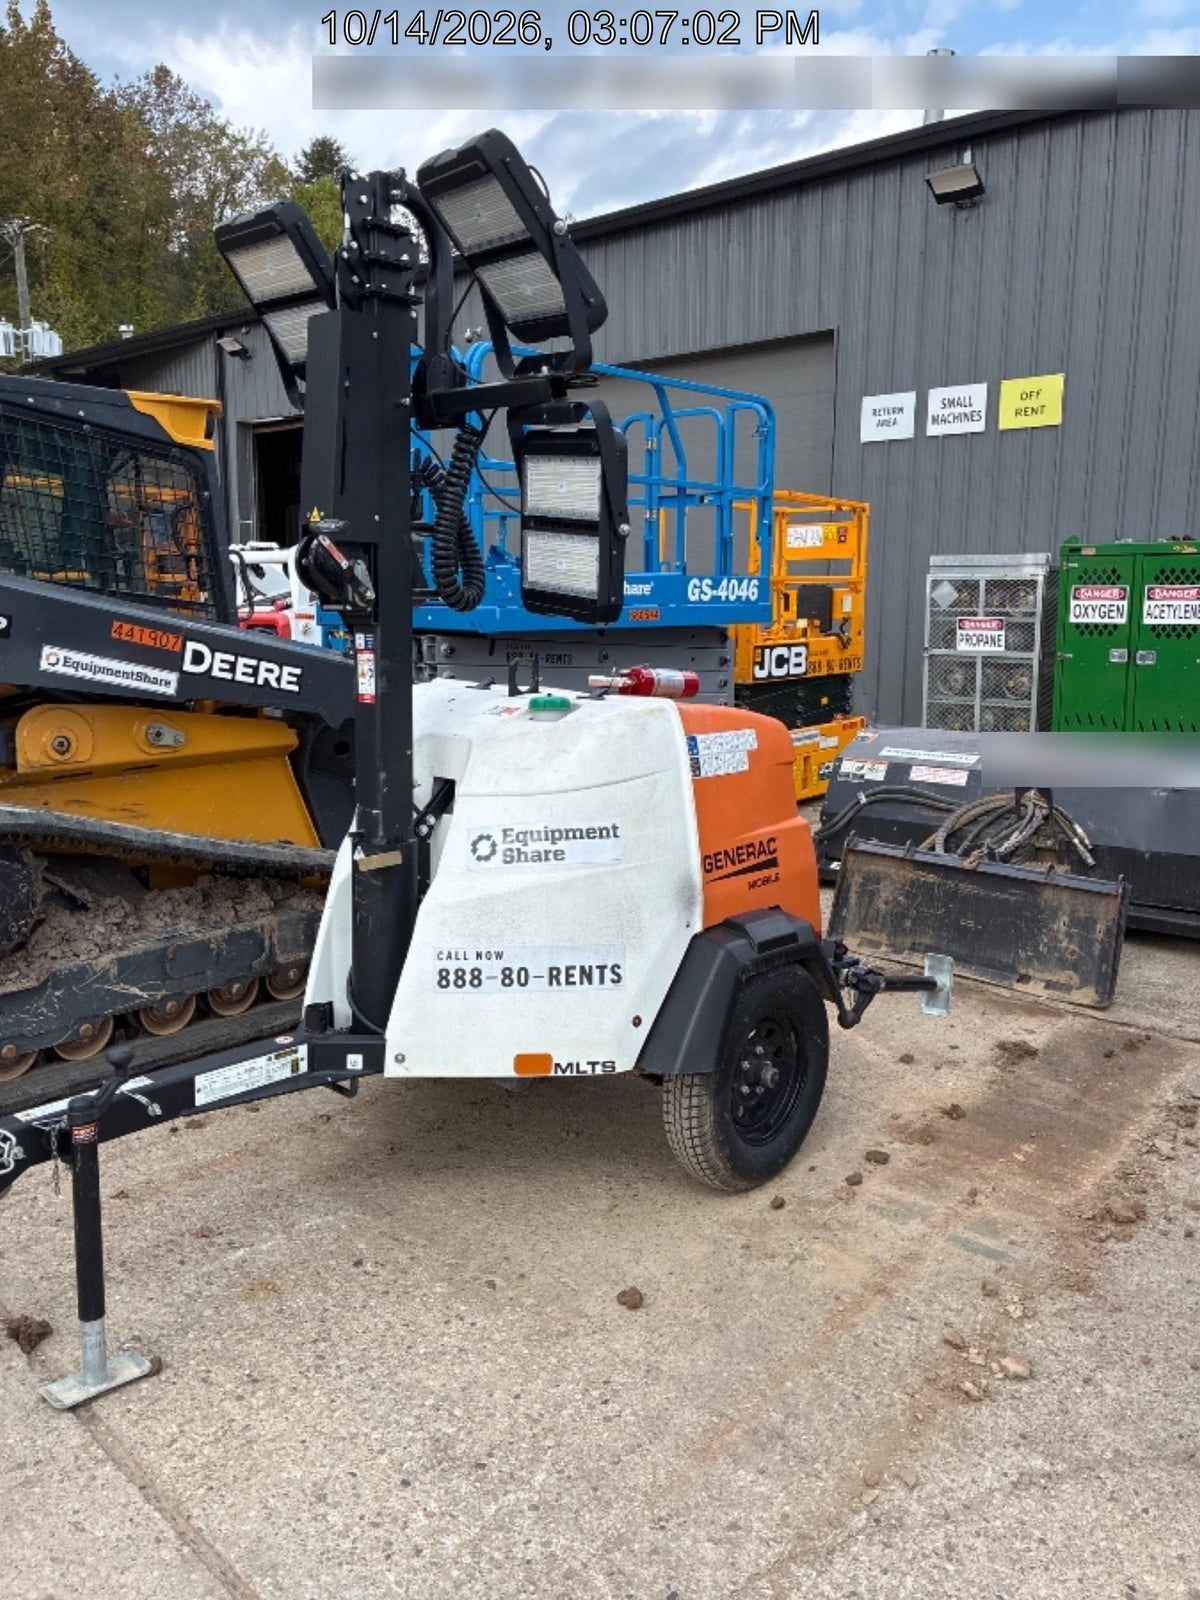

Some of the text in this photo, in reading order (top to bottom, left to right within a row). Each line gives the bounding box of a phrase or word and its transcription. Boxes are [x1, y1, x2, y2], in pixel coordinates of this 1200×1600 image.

[940, 396, 974, 409] SMALL
[1020, 390, 1043, 401] OFF
[931, 411, 983, 426] MACHINES
[1014, 405, 1047, 418] RENT
[687, 578, 759, 603] GS-4046
[1080, 586, 1119, 599] DANGER
[1154, 587, 1199, 600] DANGER
[1072, 603, 1126, 620] OXYGEN
[959, 633, 1003, 648] PROPANE
[182, 641, 302, 692] DEERE
[754, 646, 807, 678] JCB
[61, 655, 172, 688] EquipmentShare
[502, 823, 620, 846] Equipment
[502, 846, 566, 865] Share
[703, 836, 778, 874] GENERAC
[436, 951, 505, 961] CALL NOW
[436, 964, 623, 989] 888-80-RENTS
[554, 1060, 616, 1075] MLTS
